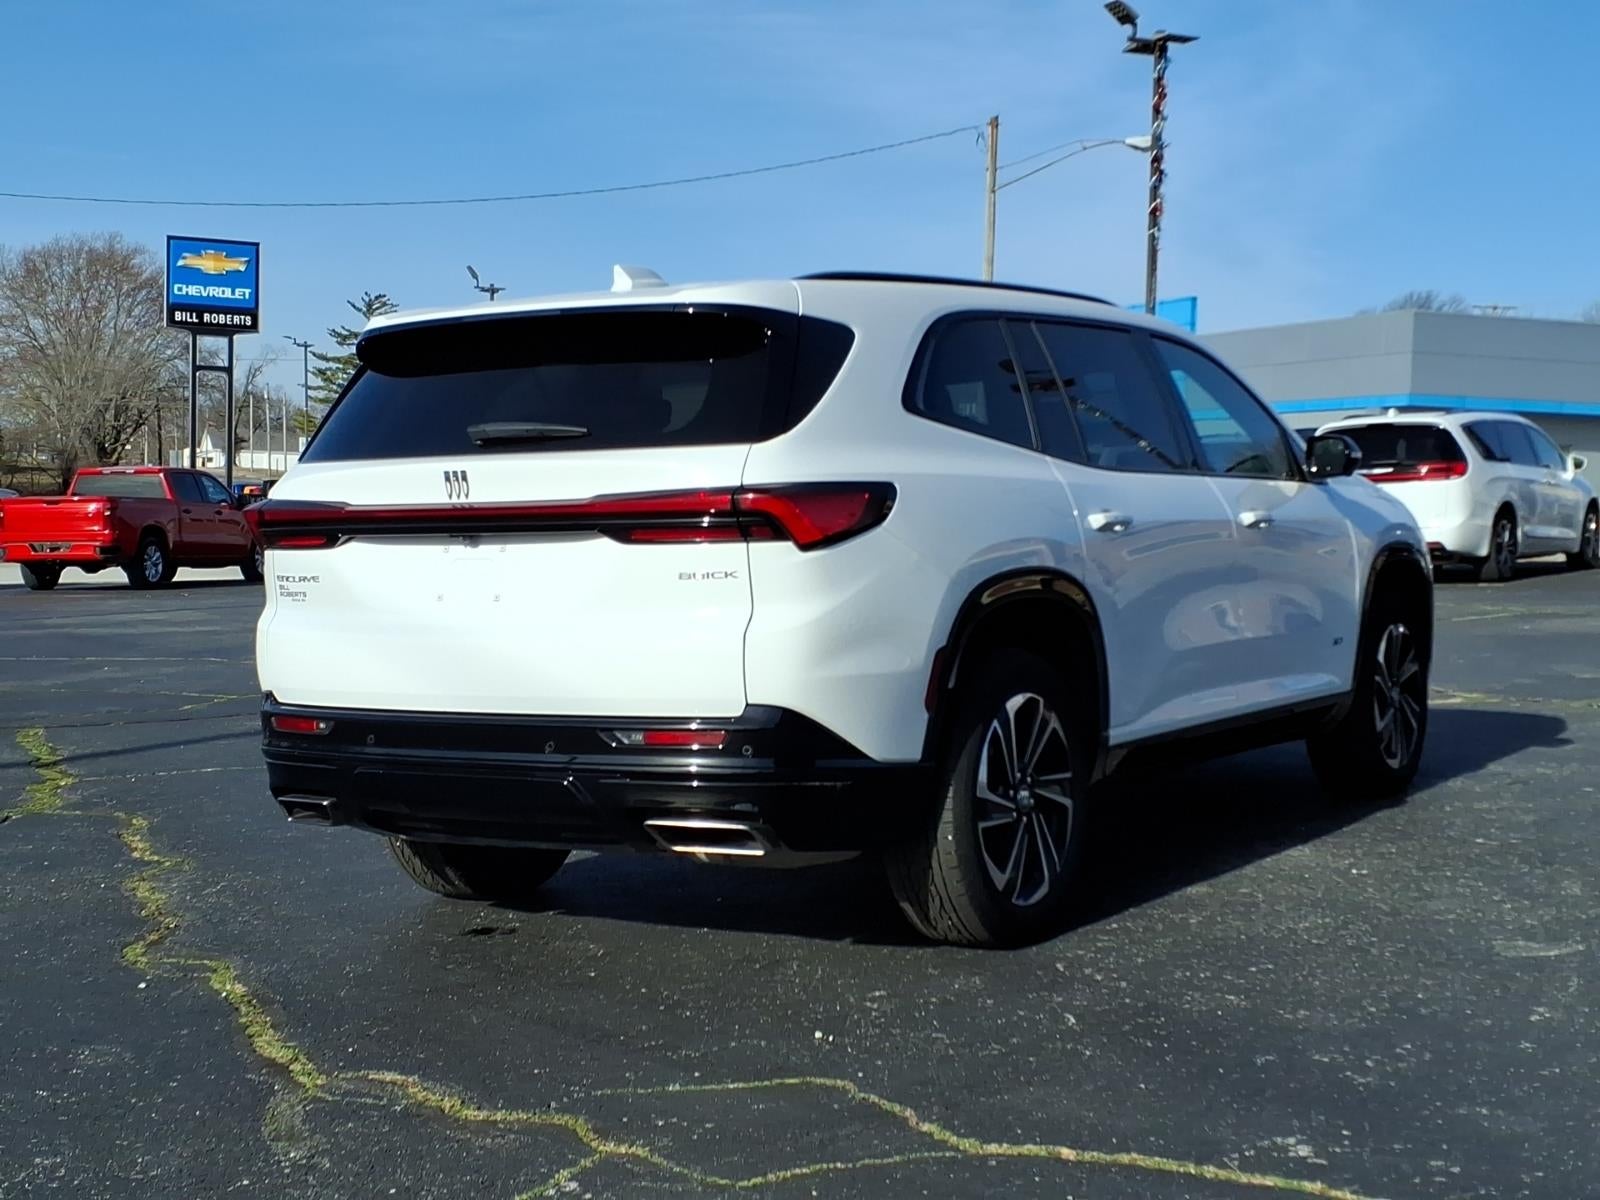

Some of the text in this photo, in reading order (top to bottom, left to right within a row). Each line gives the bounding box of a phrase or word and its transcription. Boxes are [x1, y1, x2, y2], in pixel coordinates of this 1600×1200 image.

[173, 283, 252, 300] CHEVROLET
[174, 310, 252, 326] BILL ROBERTS
[678, 570, 739, 581] BUICK
